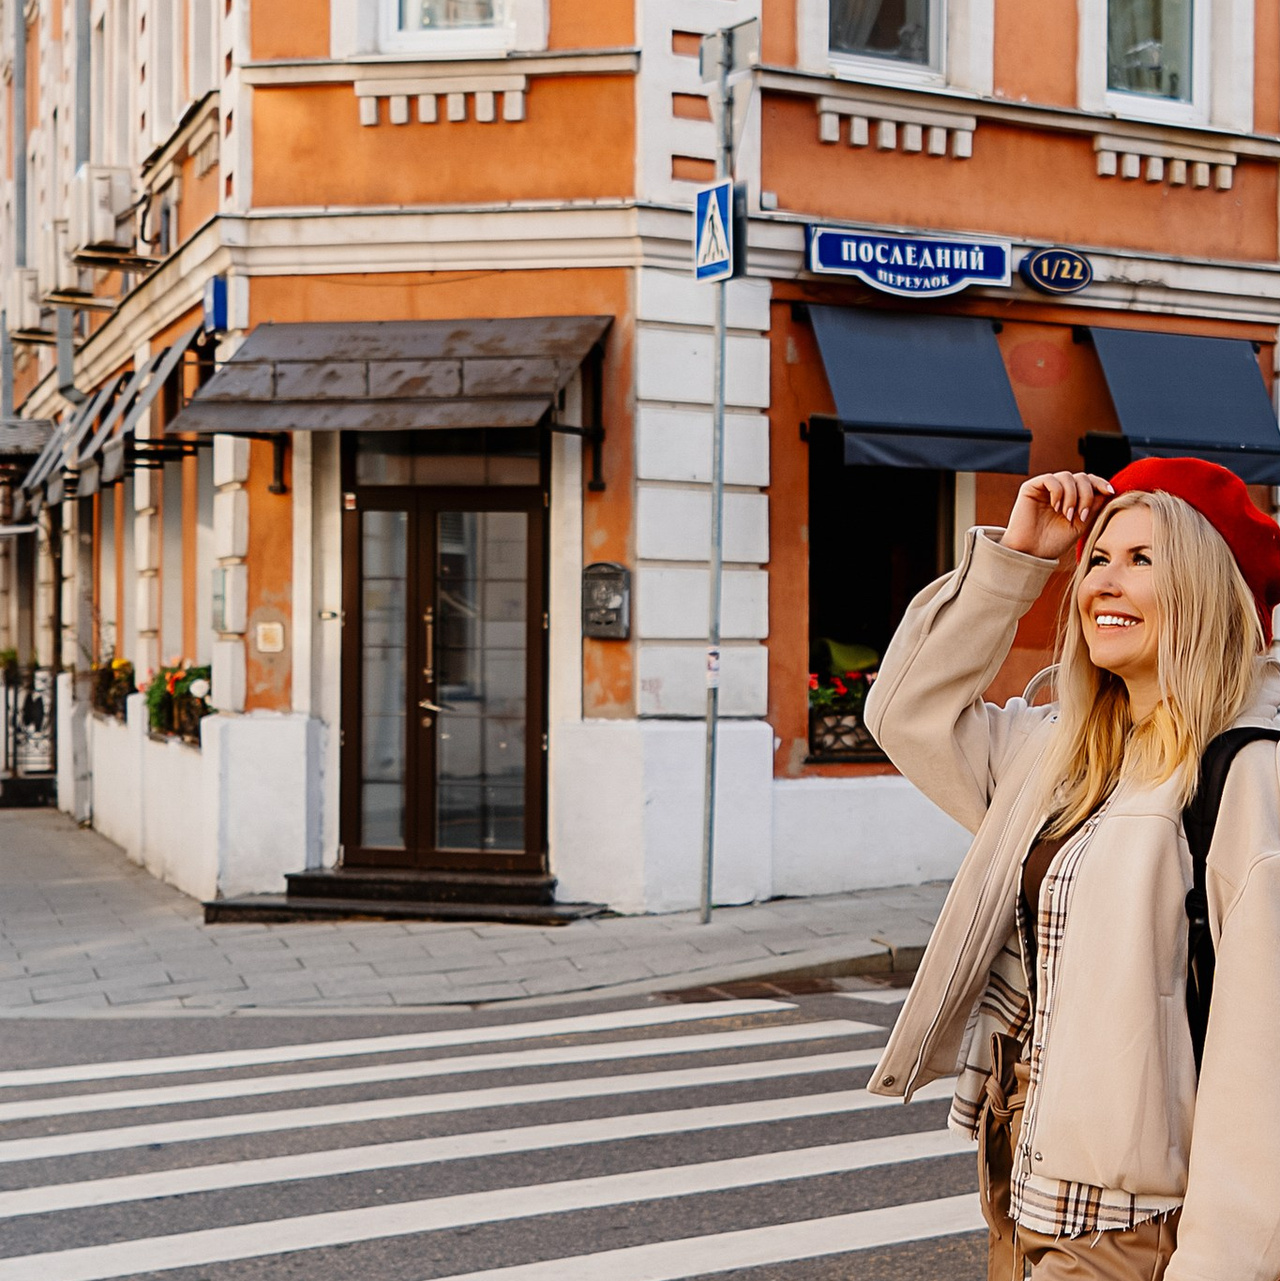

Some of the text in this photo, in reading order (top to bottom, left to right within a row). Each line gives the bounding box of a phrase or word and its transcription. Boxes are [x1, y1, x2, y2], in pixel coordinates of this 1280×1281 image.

[841, 239, 985, 271] ПОСЛЕДНИЙ
[877, 269, 950, 289] ПЕРЕУЛОК
[1042, 258, 1084, 280] 1/22
